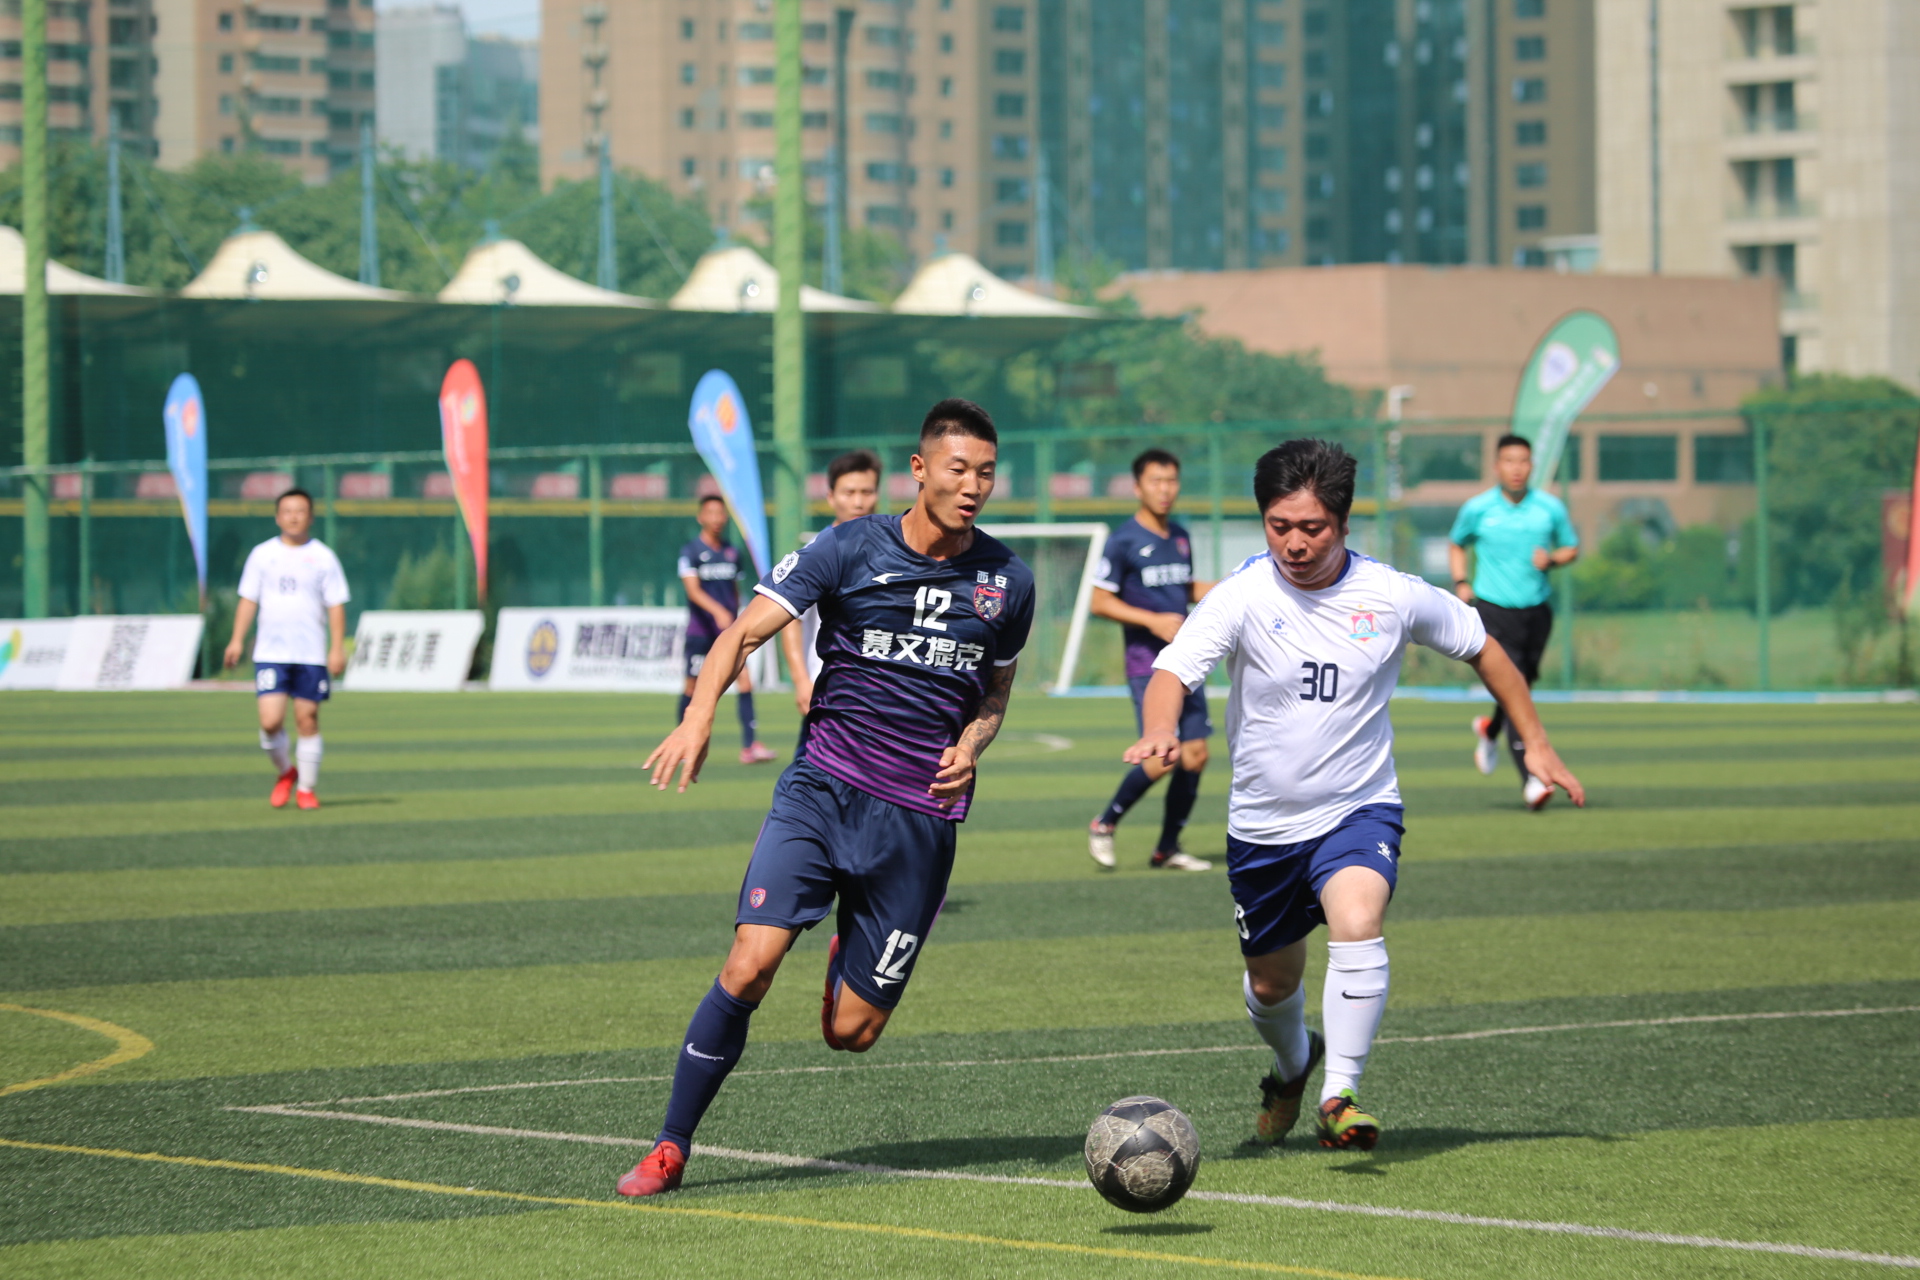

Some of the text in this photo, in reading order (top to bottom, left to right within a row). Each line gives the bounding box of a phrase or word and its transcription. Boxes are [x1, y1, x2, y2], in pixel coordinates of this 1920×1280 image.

[976, 570, 1008, 589] 西安
[913, 585, 953, 632] 12
[861, 628, 985, 671] 赛文提克
[1299, 661, 1338, 702] 30
[875, 929, 918, 980] 12
